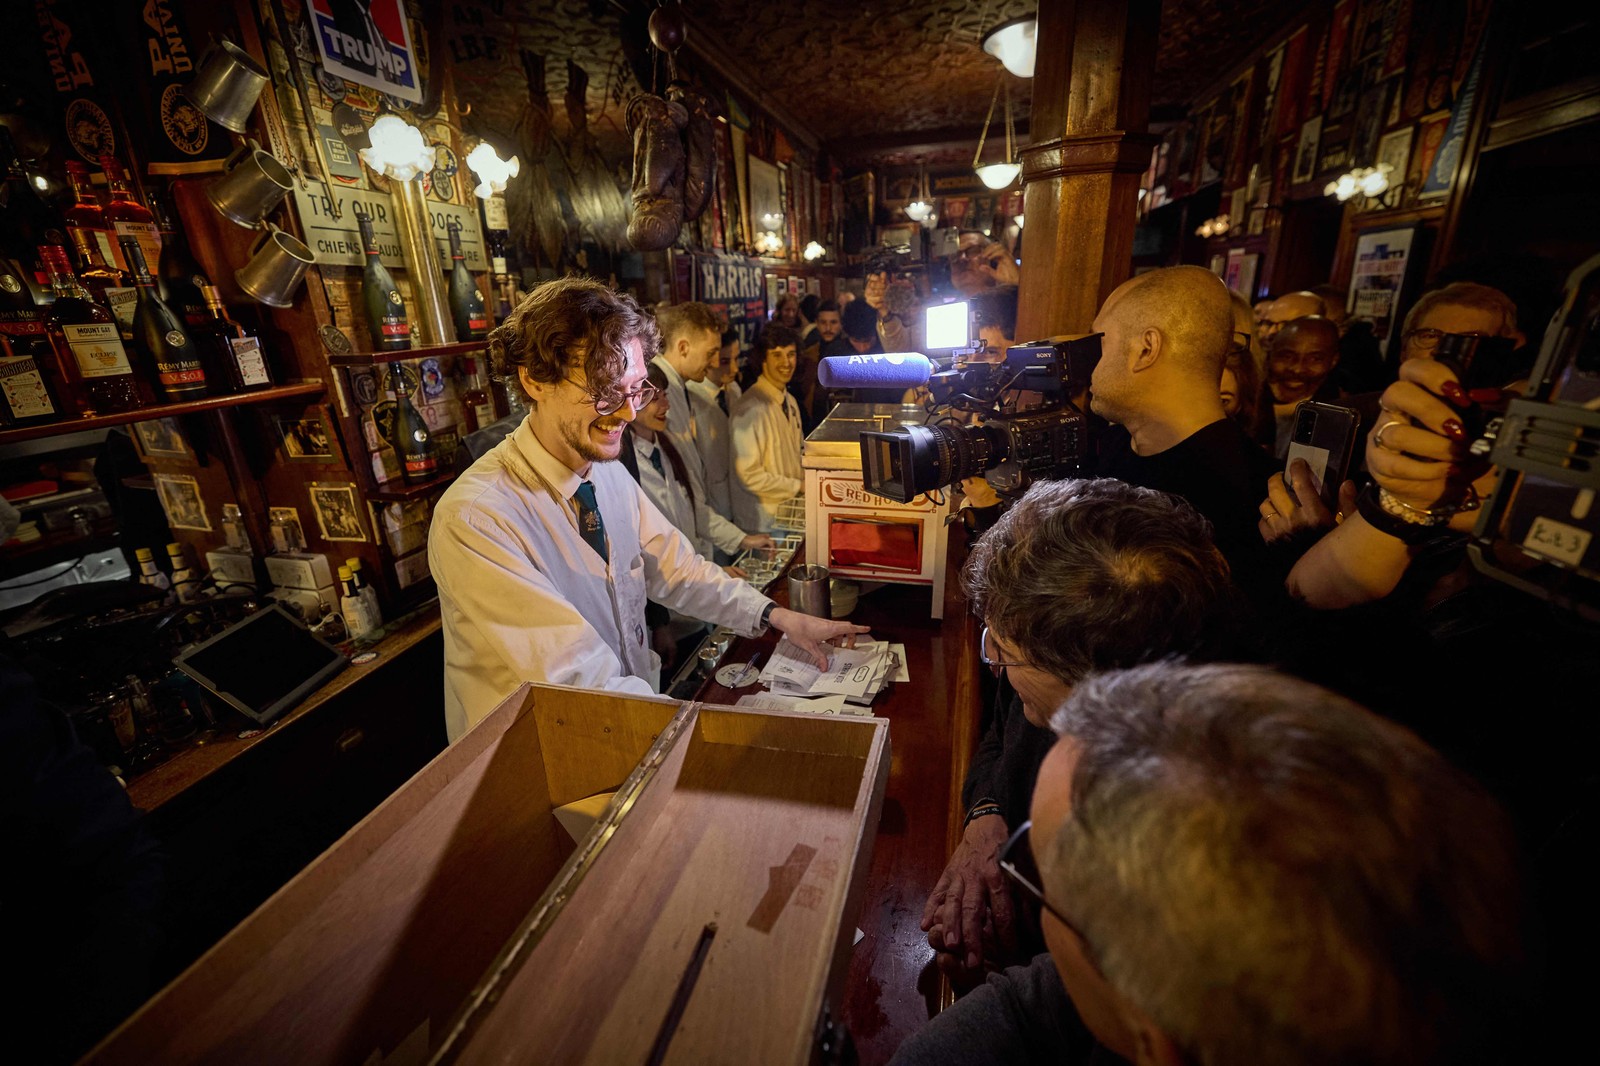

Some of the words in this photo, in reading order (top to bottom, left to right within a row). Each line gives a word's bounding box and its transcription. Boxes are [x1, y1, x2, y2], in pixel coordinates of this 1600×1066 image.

[323, 25, 407, 76] TRUMP
[308, 194, 343, 217] TRY
[353, 200, 388, 223] OUR
[317, 239, 361, 255] CHIENS
[701, 263, 763, 299] HARRIS
[1059, 416, 1081, 424] SONY
[846, 488, 871, 504] RED
[1566, 534, 1581, 553] 3
